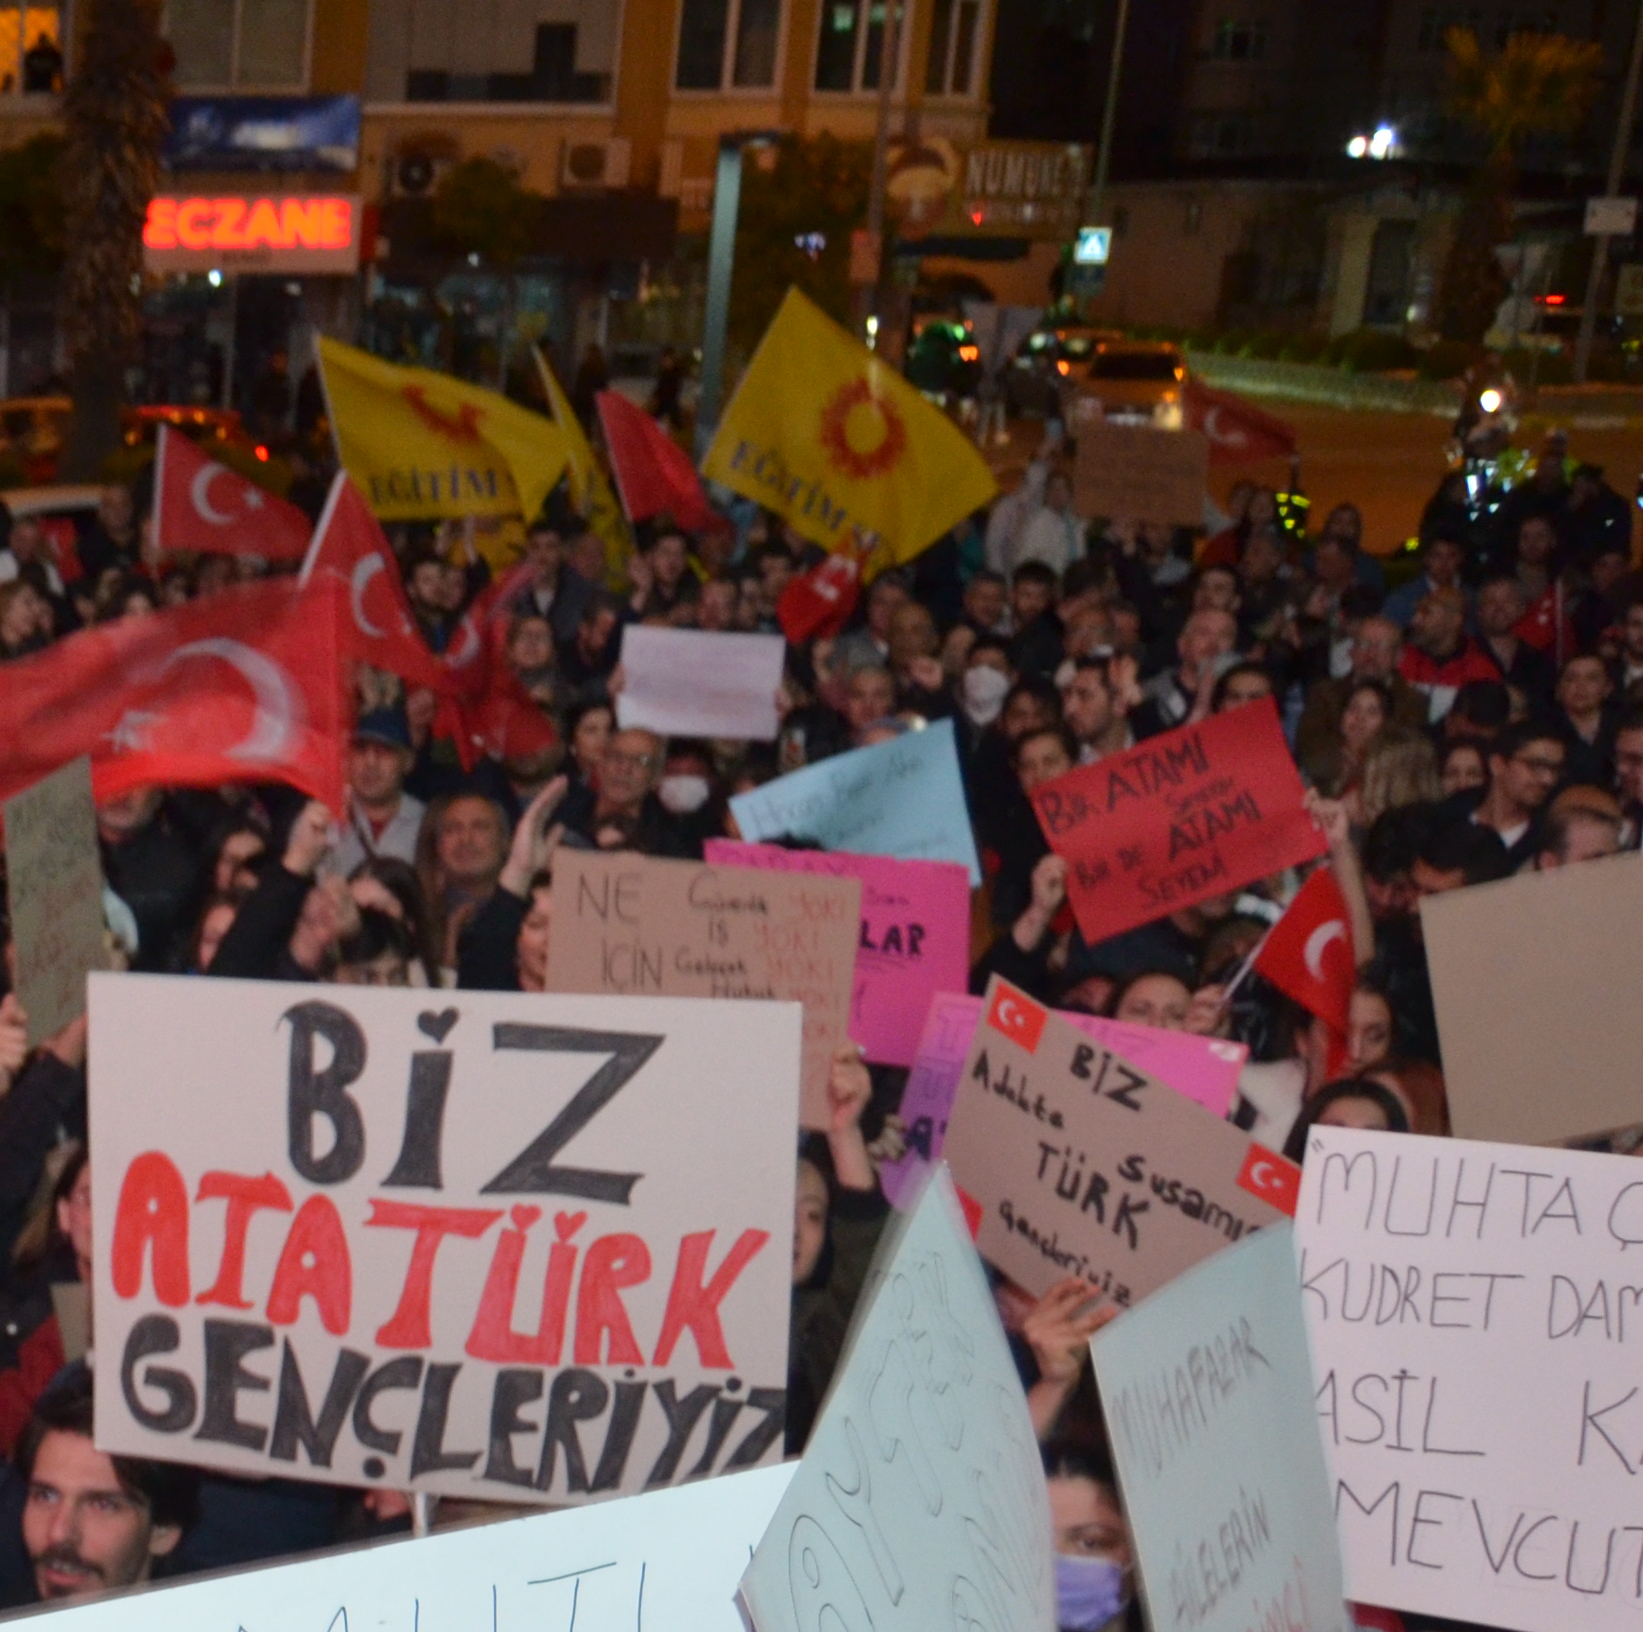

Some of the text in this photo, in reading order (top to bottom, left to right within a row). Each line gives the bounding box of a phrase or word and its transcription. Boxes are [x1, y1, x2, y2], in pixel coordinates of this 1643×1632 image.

[143, 198, 351, 248] ECZANE
[276, 999, 666, 1206] BİZ
[1070, 1044, 1149, 1111] BİZ
[1038, 1140, 1150, 1250] TÜRK
[111, 1151, 771, 1369] ATATÜRK
[1300, 1248, 1526, 1332] KUDRET
[121, 1314, 785, 1495] GENÇLERİYİZ
[1315, 1368, 1486, 1457] ASİL
